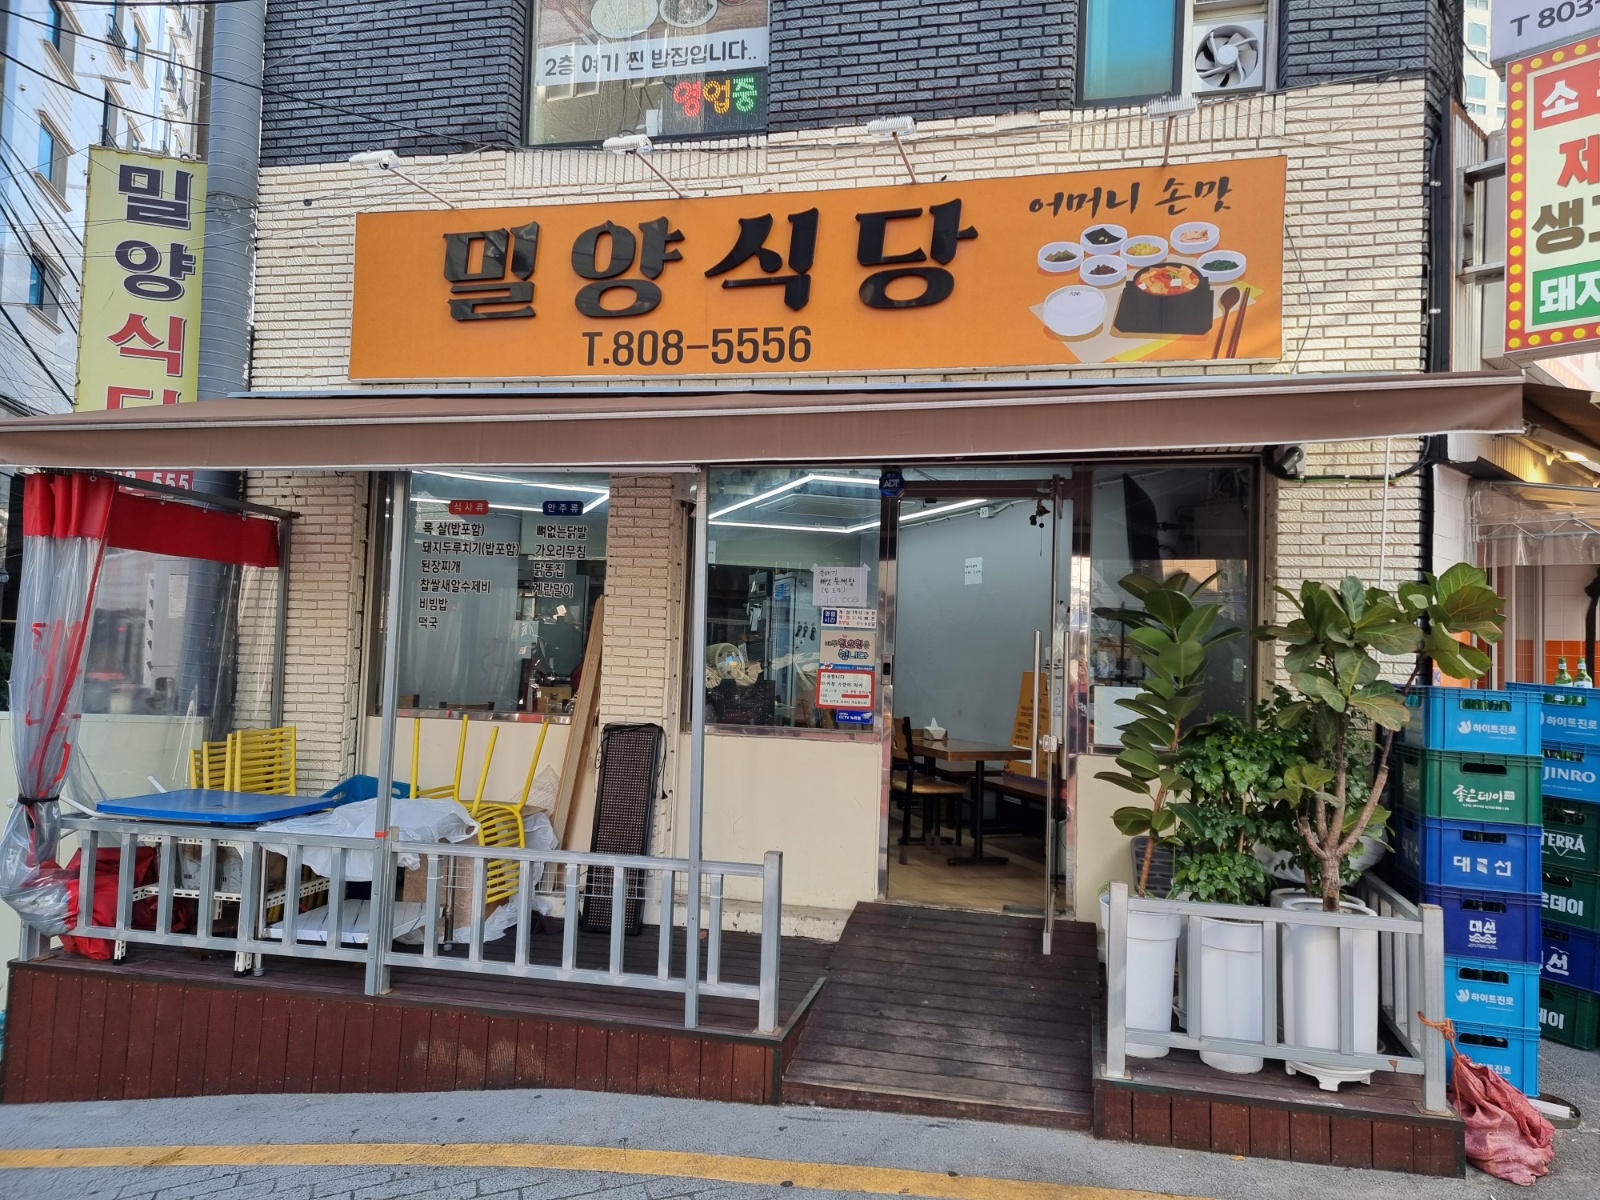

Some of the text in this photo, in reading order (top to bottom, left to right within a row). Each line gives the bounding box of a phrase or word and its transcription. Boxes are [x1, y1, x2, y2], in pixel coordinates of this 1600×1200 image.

[1510, 15, 1530, 37] T
[545, 54, 575, 77] 2층
[626, 50, 644, 71] 찐
[673, 76, 758, 117] 영업중
[1028, 176, 1234, 219] 어머니 손맛
[442, 198, 979, 322] 밀양식당
[582, 325, 812, 367] T.808-5556
[883, 478, 900, 488] ADT
[536, 524, 588, 540] 뼈없는닭발
[422, 541, 521, 558] 돼지두루치기(밥포함)
[535, 544, 587, 559] 가오리무침
[420, 560, 461, 574] 된장찌개
[533, 562, 565, 578] 닭똥집
[420, 579, 491, 594] 찹쌀새알수제비
[532, 582, 574, 598] 계란말이
[419, 598, 448, 611] 비빔밥
[418, 616, 439, 630] 떡국
[1473, 723, 1517, 735] 하이트진로
[1546, 716, 1598, 730] 하이트진로
[1542, 765, 1596, 783] JINRO
[1452, 785, 1503, 803] 좋은데이
[1469, 919, 1497, 934] 대선
[1471, 992, 1514, 1005] 하이트진로
